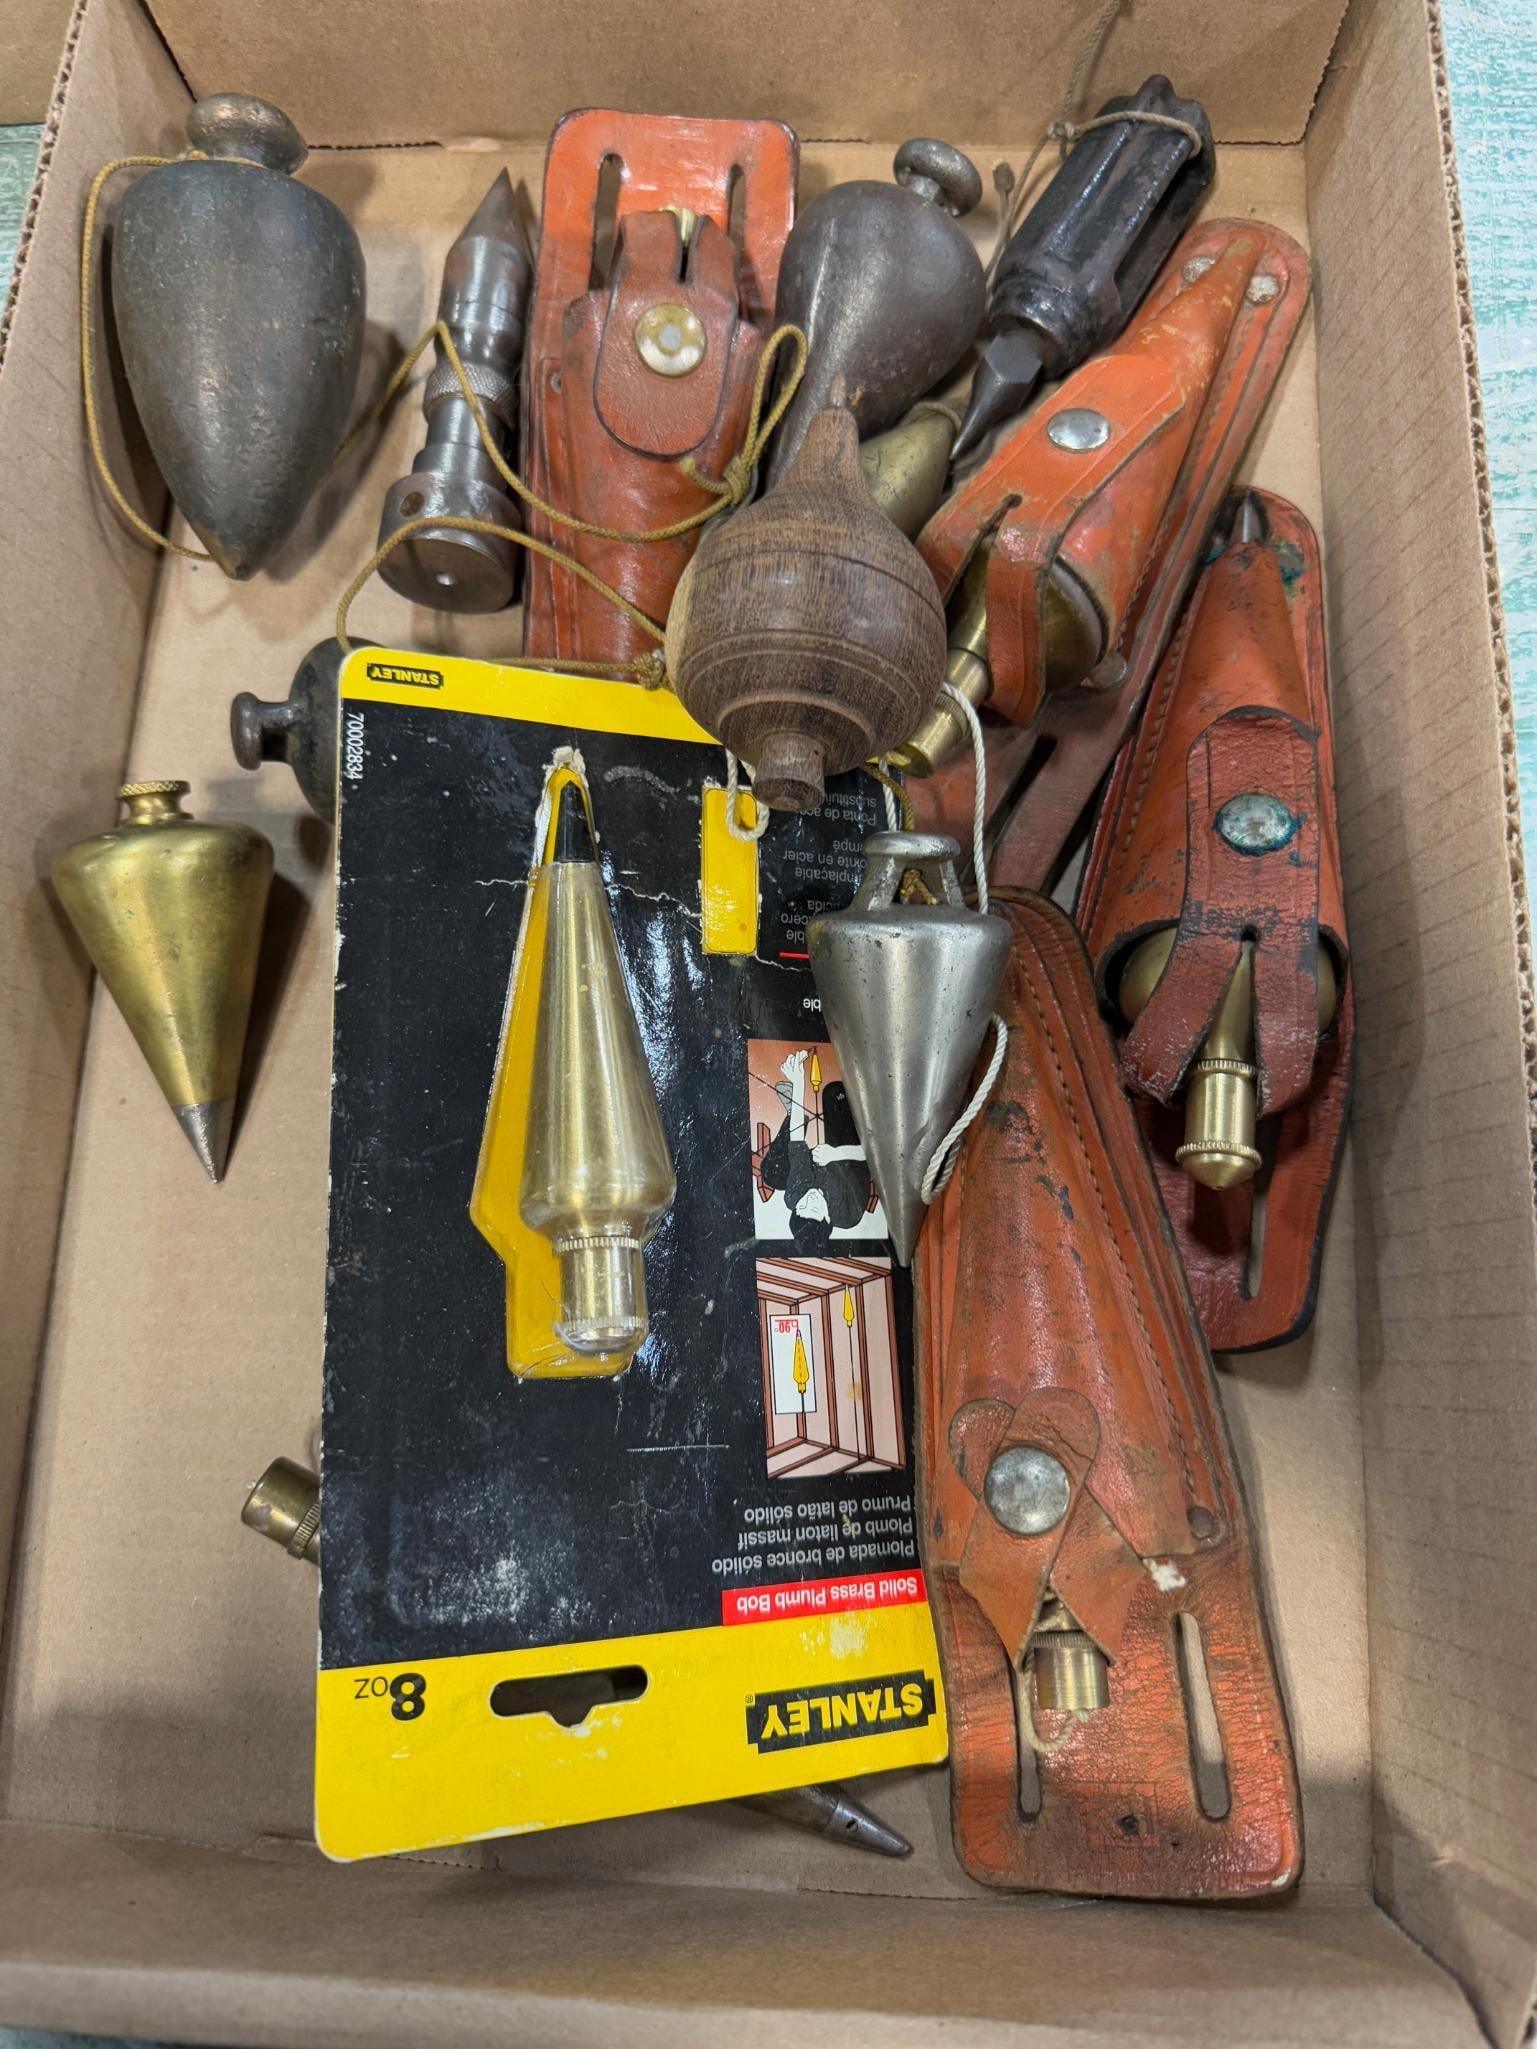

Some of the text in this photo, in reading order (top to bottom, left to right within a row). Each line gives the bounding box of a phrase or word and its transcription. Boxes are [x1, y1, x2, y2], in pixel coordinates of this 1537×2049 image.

[370, 666, 440, 686] STANLEY
[344, 712, 365, 781] 70002834
[824, 808, 839, 820] de
[843, 811, 876, 826] Ponta
[782, 850, 868, 869] ointe en acier
[779, 913, 809, 925] cero
[744, 1495, 911, 1526] Prumo de latão sólido
[842, 1521, 861, 1538] de
[865, 1517, 913, 1537] Plomb
[737, 1529, 792, 1550] massif
[711, 1539, 915, 1576] Plomada de bronce sólido
[737, 1576, 918, 1614] Solid Brass Plumb Bob
[761, 1683, 923, 1740] STANLEY
